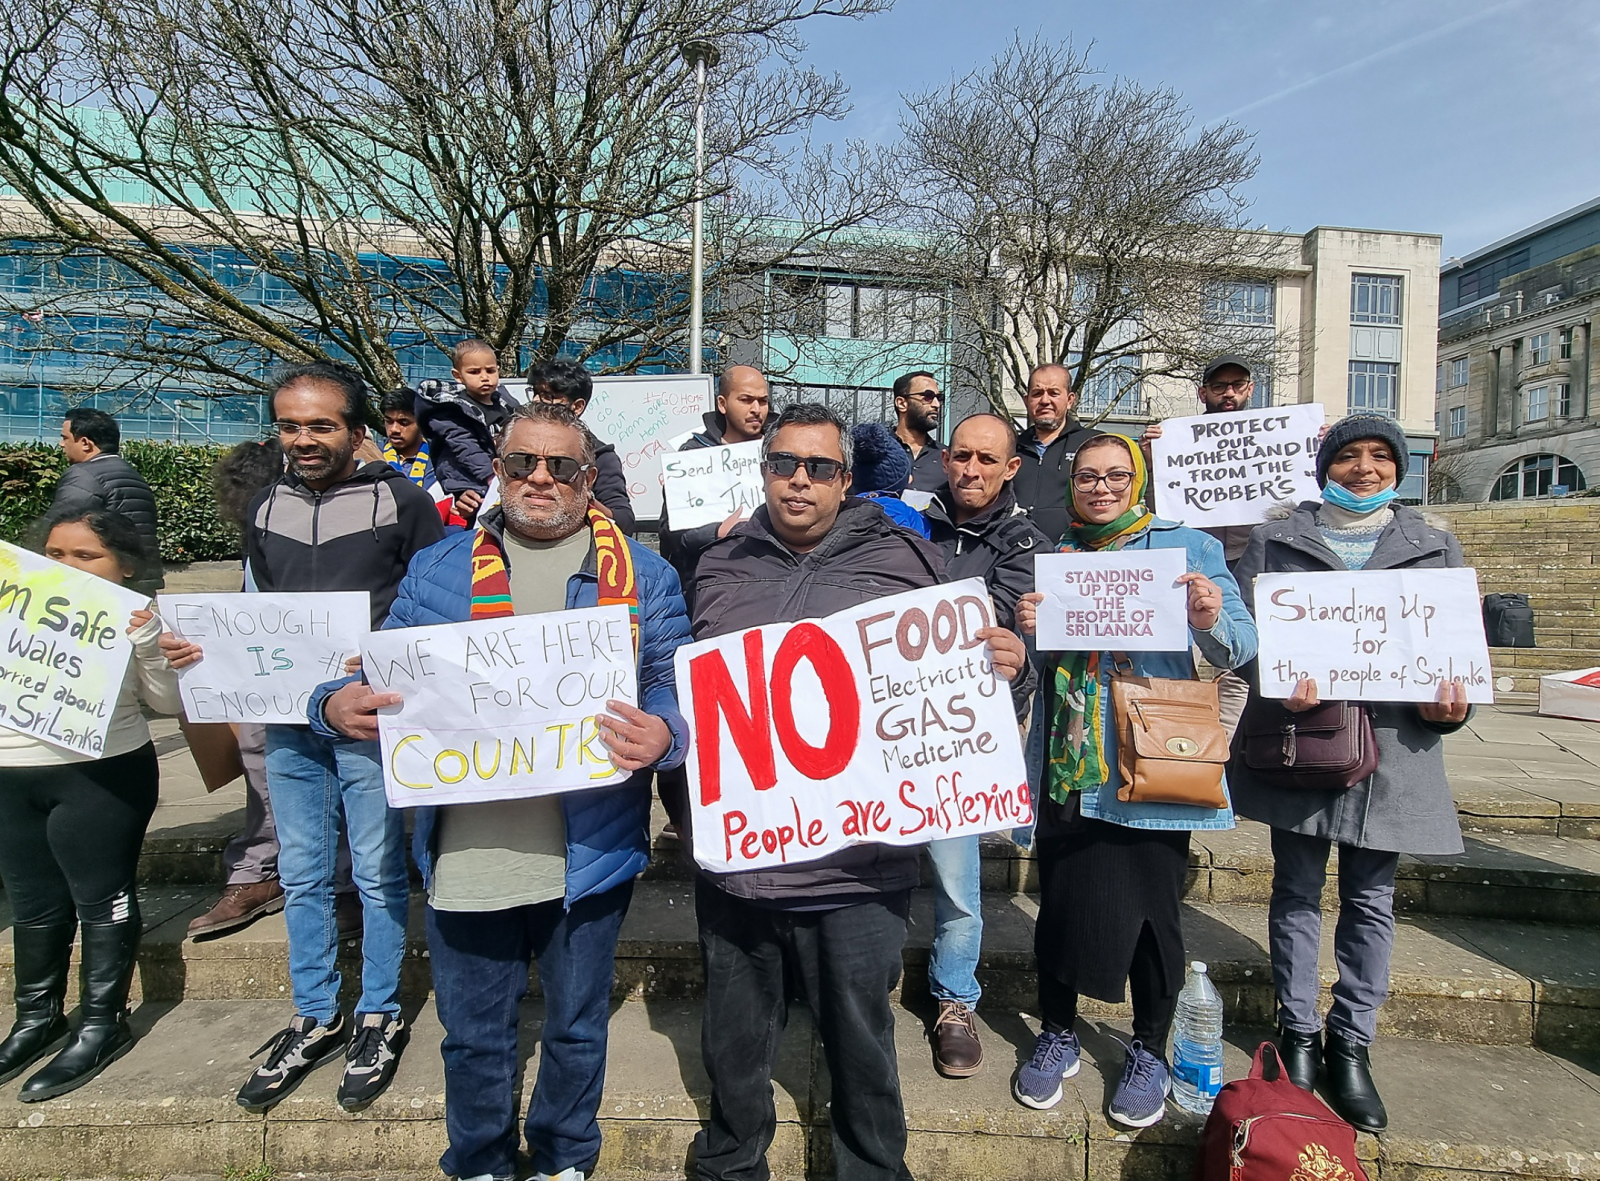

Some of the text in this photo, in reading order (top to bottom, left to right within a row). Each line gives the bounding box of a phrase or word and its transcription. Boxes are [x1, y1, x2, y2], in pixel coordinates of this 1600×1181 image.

[587, 390, 610, 413] OTA
[597, 407, 613, 423] GO
[1191, 416, 1291, 443] PROTECT
[1216, 435, 1258, 450] OUR
[666, 455, 714, 480] Send
[1188, 459, 1295, 484] FROM THE
[686, 490, 704, 508] to
[1064, 569, 1154, 584] STANDING
[1079, 583, 1140, 597] UP FOR
[1065, 609, 1155, 623] PEOPLE OF
[1093, 596, 1125, 610] THE
[1269, 586, 1387, 634] Standing
[175, 603, 331, 638] ENOUGH
[1065, 623, 1154, 637] SRI LANKA
[855, 595, 991, 676] FOOD
[1352, 628, 1387, 655] for
[247, 646, 295, 677] IS
[367, 619, 624, 688] WE ARE HERE
[469, 669, 632, 715] FOR OUR
[869, 656, 997, 704] Electricity
[1329, 662, 1382, 696] people
[1390, 665, 1408, 689] of
[53, 685, 106, 719] about
[688, 622, 861, 808] NO
[875, 692, 977, 742] GAS
[882, 731, 998, 774] Medicine
[722, 771, 1034, 864] People are Suffering
